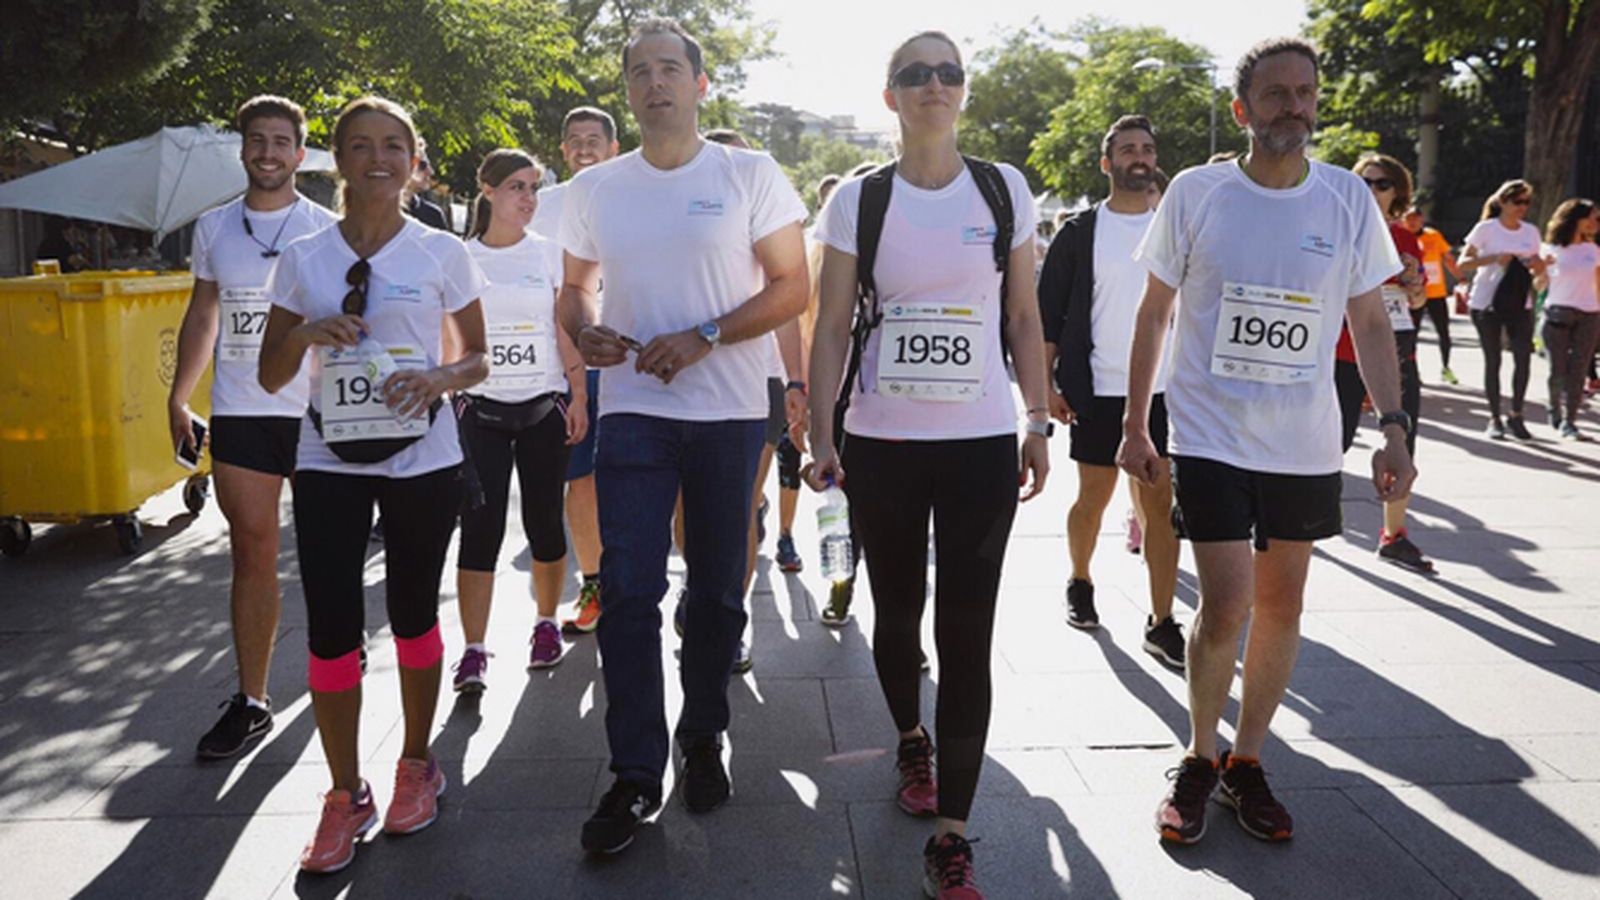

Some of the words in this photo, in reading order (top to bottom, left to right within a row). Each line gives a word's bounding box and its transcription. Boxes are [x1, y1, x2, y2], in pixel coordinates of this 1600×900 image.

[1227, 315, 1309, 352] 1960
[492, 343, 536, 366] 564
[894, 334, 972, 366] 1958
